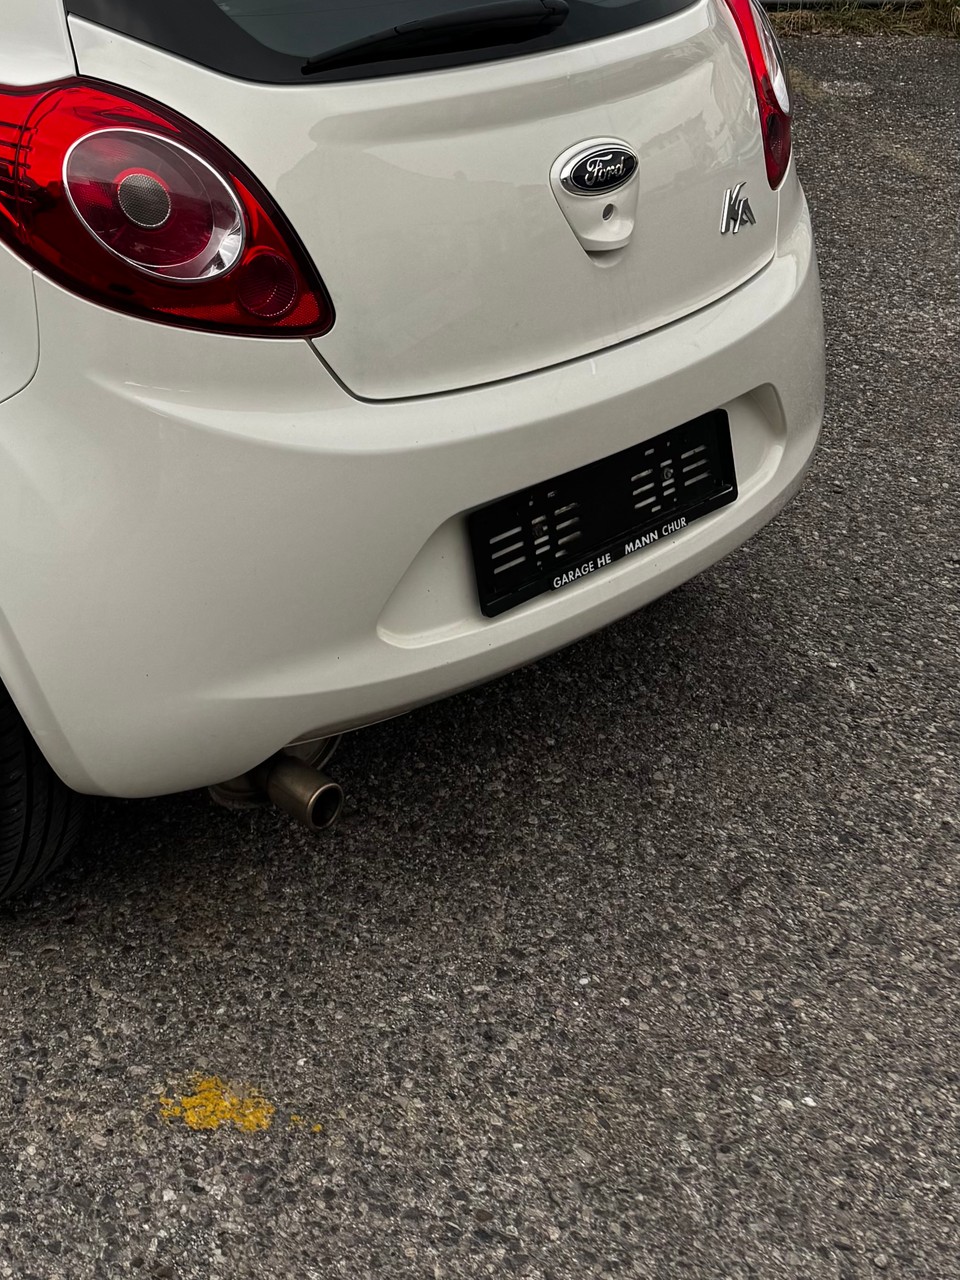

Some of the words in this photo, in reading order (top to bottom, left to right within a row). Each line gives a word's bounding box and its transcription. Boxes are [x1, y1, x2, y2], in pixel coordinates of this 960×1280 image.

[585, 153, 627, 186] Ford
[553, 560, 595, 588] GARAGE
[624, 530, 659, 555] MANN
[661, 517, 688, 536] CHUR
